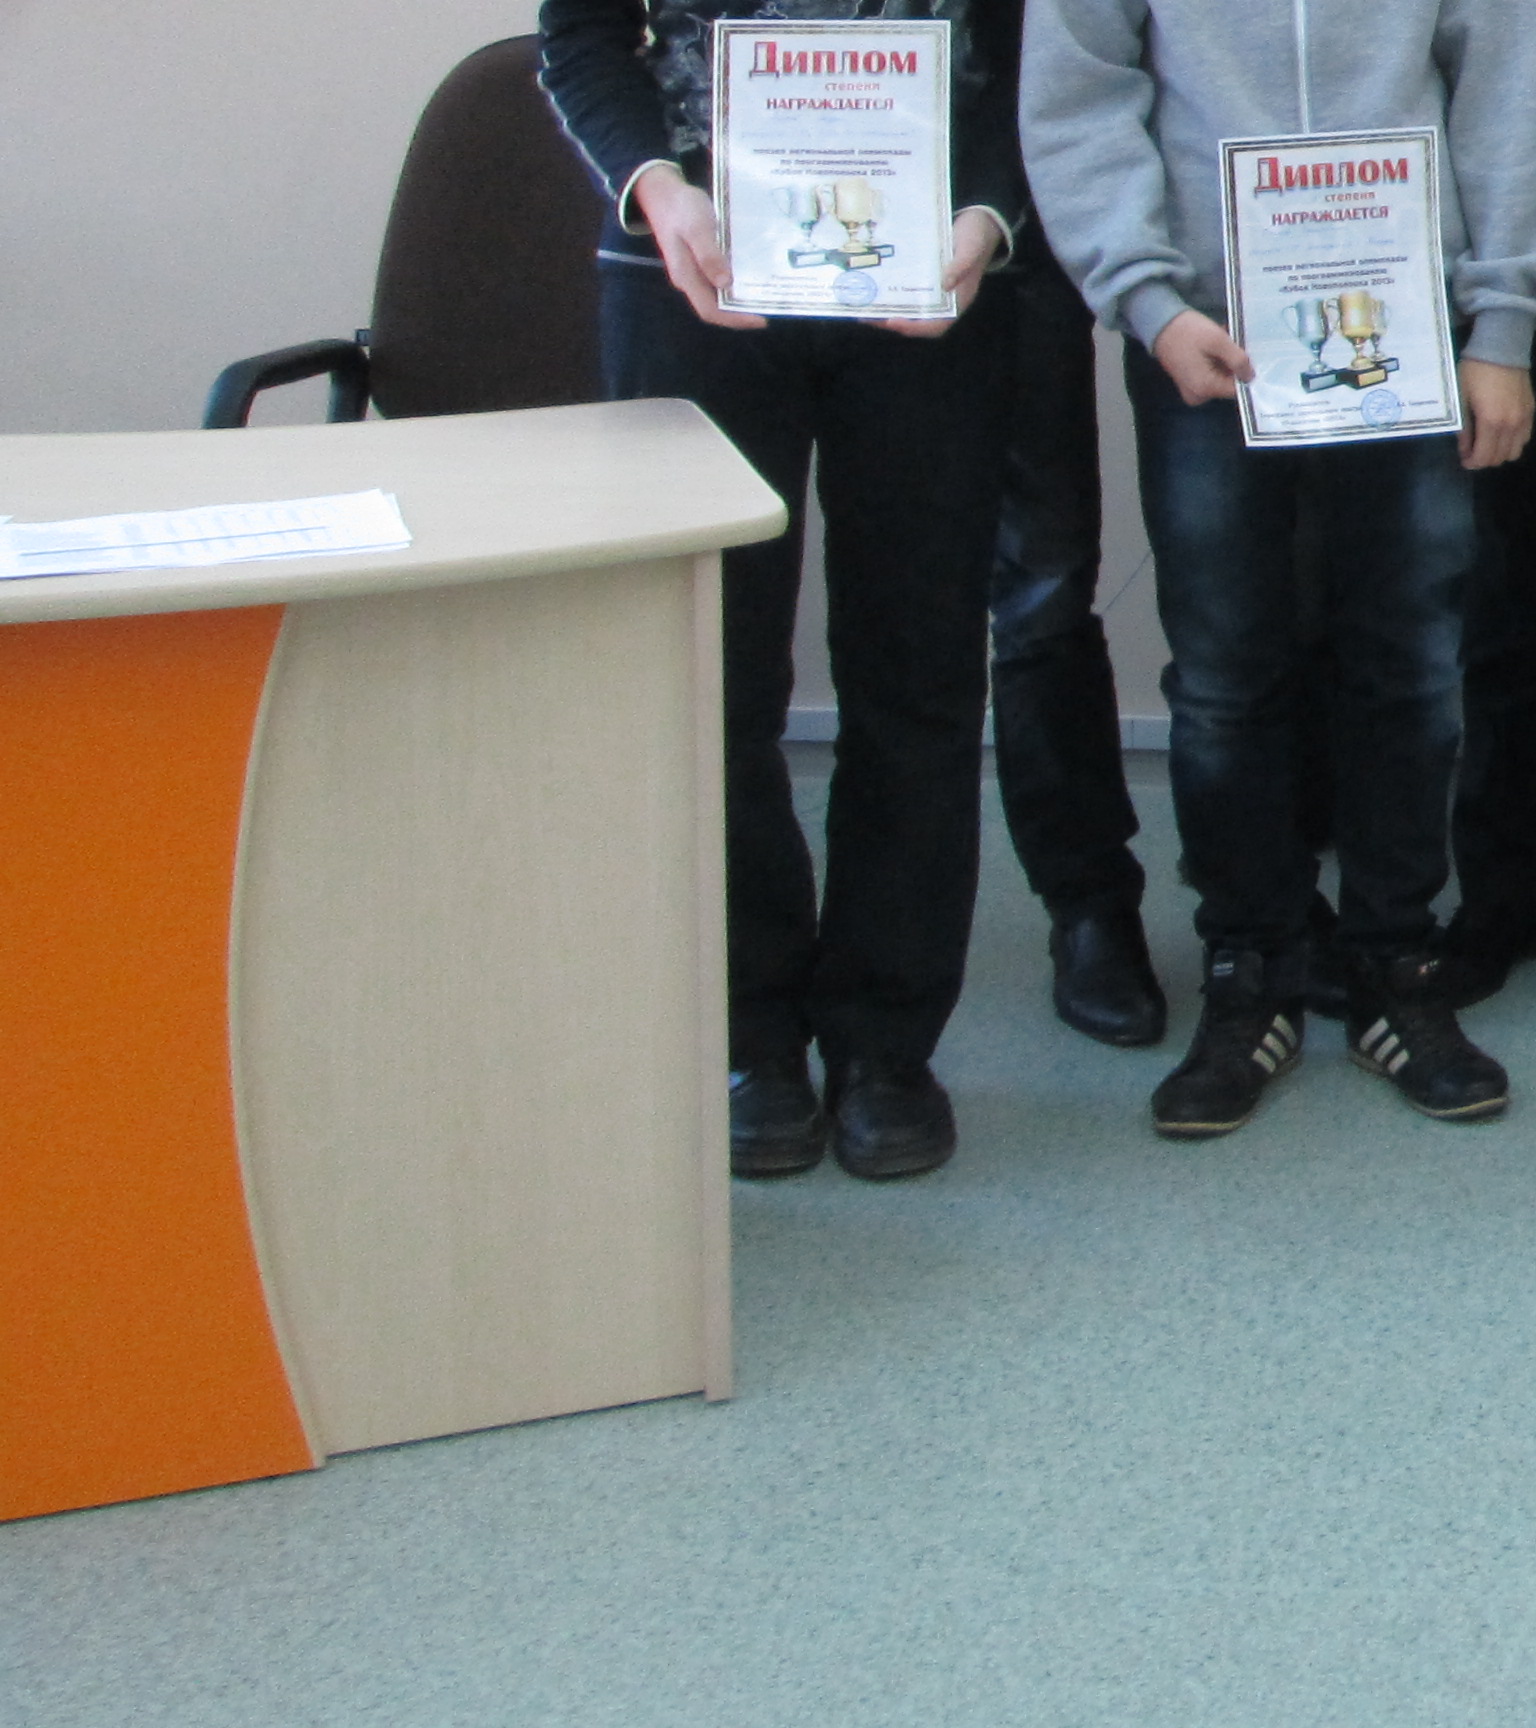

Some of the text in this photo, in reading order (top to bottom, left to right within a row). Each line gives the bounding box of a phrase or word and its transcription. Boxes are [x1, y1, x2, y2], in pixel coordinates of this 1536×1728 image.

[749, 40, 919, 80] Диплом
[824, 80, 880, 92] степени
[766, 97, 895, 111] НАГРАЖДАЕТСЯ
[1253, 156, 1409, 197] Диплом
[1271, 205, 1389, 227] НАГРАЖДАЕТСЯ
